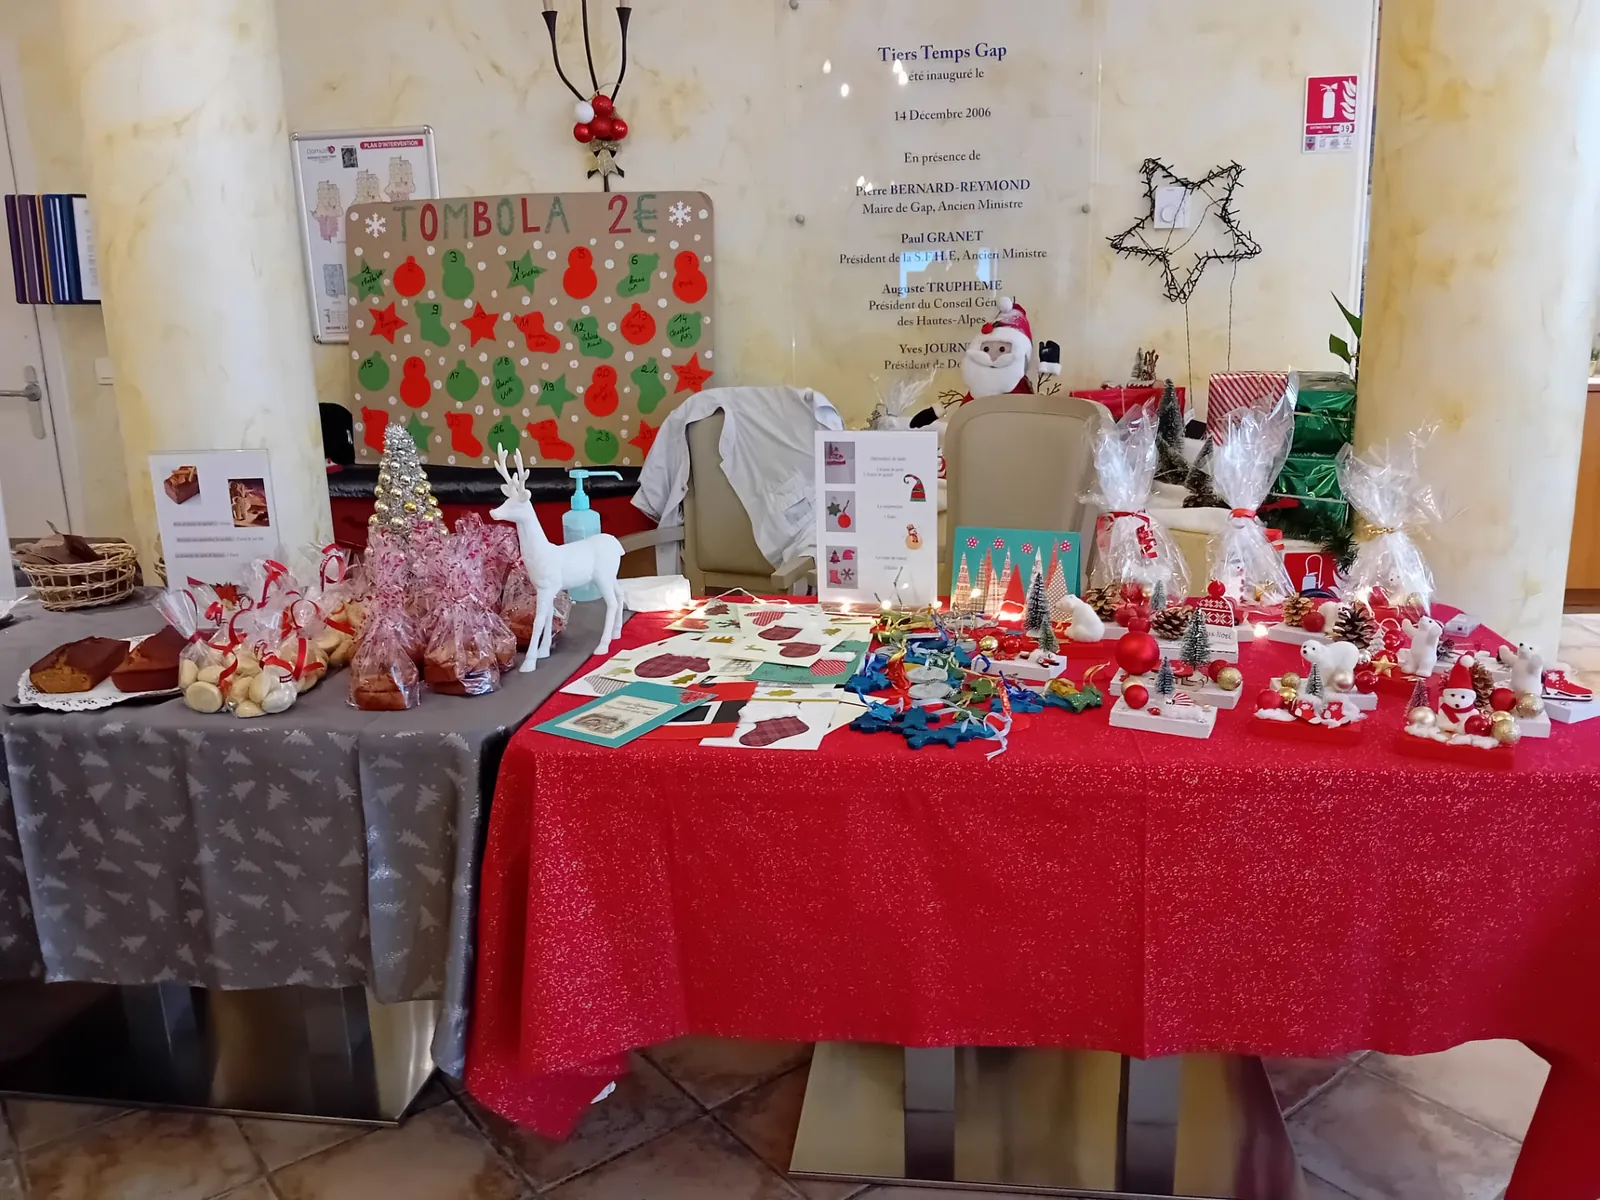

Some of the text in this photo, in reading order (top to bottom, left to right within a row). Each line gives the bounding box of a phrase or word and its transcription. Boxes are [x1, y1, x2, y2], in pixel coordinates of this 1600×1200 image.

[877, 42, 1007, 63] Tiers Temps Gap
[908, 68, 985, 83] été inauguré le
[894, 107, 992, 121] 14 Décembre 2006
[904, 150, 982, 166] En présence de
[855, 179, 1031, 197] Pierre BERNARD-REYMOND
[862, 198, 1024, 215] Maire de Gap, Ancien Ministre
[393, 196, 570, 242] TOMBOLA
[900, 230, 984, 245] Paul GRANET
[449, 251, 458, 263] 3
[631, 255, 639, 265] 6
[839, 253, 887, 265] Président
[888, 252, 901, 264] de
[902, 251, 912, 262] la
[961, 249, 1000, 261] Ancien
[1001, 247, 1048, 260] Ministre
[881, 279, 1003, 298] Auguste TRUPHEME
[431, 304, 440, 316] 9
[868, 298, 916, 311] Président
[917, 298, 931, 310] du
[933, 296, 973, 309] Conseil
[896, 314, 987, 328] des Hautes-Alpes
[898, 342, 972, 357] Yves JOURN
[361, 359, 374, 370] 15
[884, 359, 931, 371] Président
[932, 358, 945, 370] de
[449, 371, 460, 380] 17
[542, 382, 555, 392] 19
